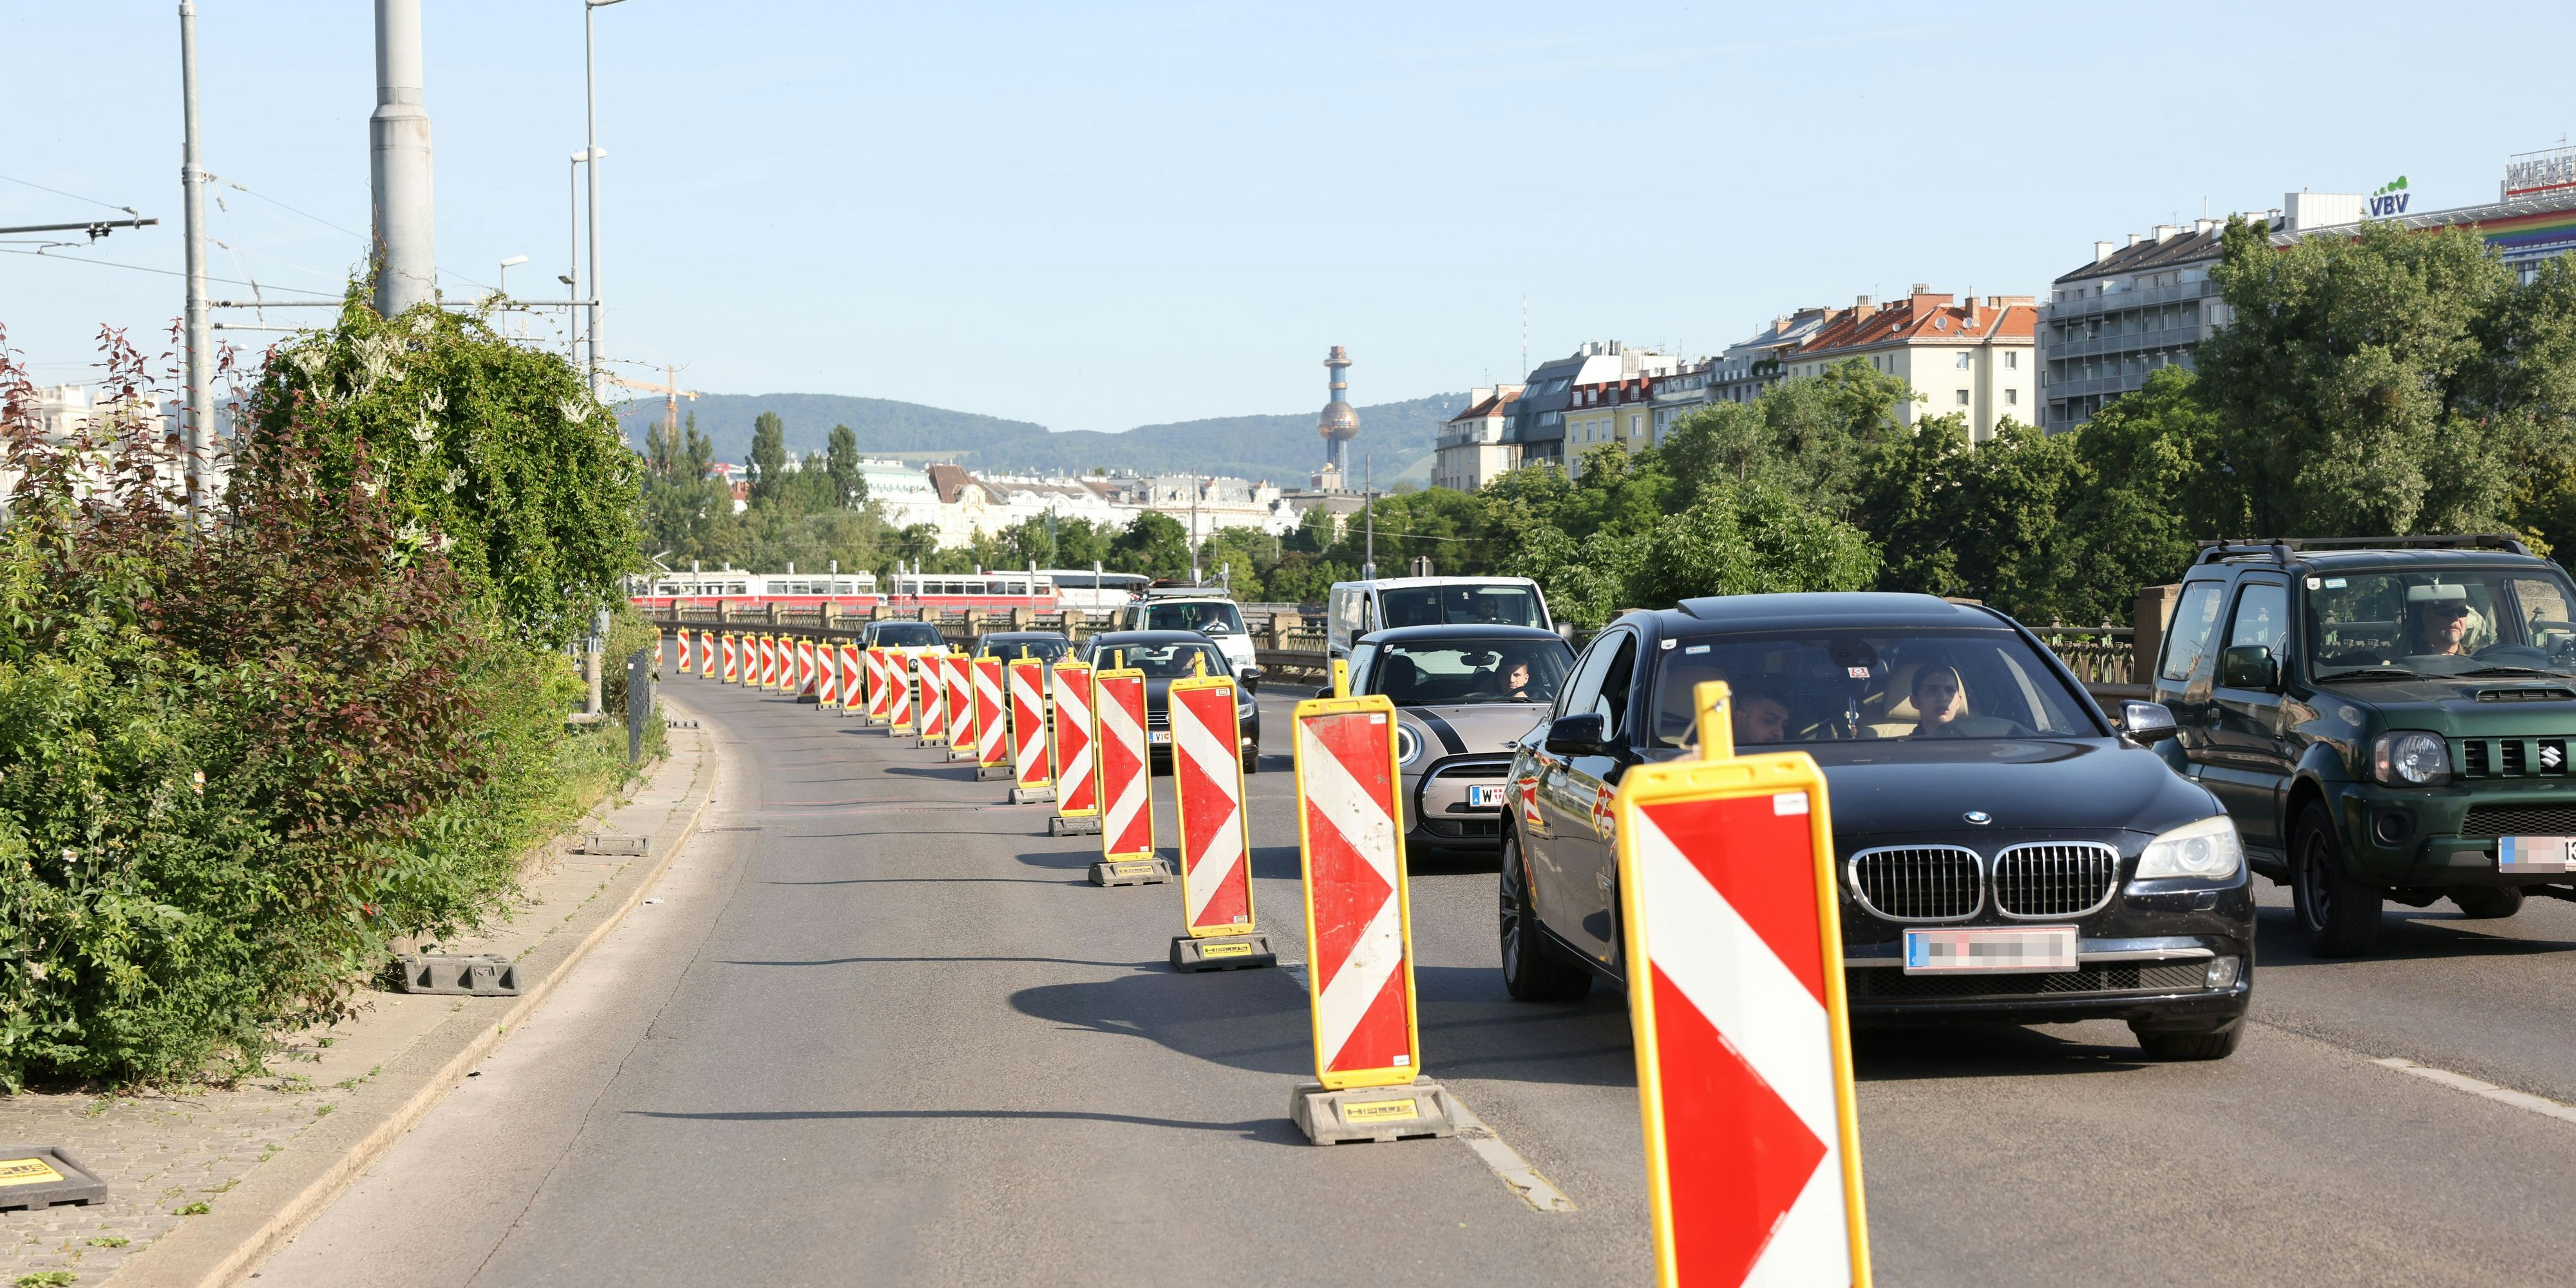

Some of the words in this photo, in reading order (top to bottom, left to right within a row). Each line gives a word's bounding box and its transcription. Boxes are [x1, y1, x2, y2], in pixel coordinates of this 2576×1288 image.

[2506, 155, 2576, 185] WIENE
[2369, 193, 2410, 216] VBV
[1482, 789, 1492, 802] W
